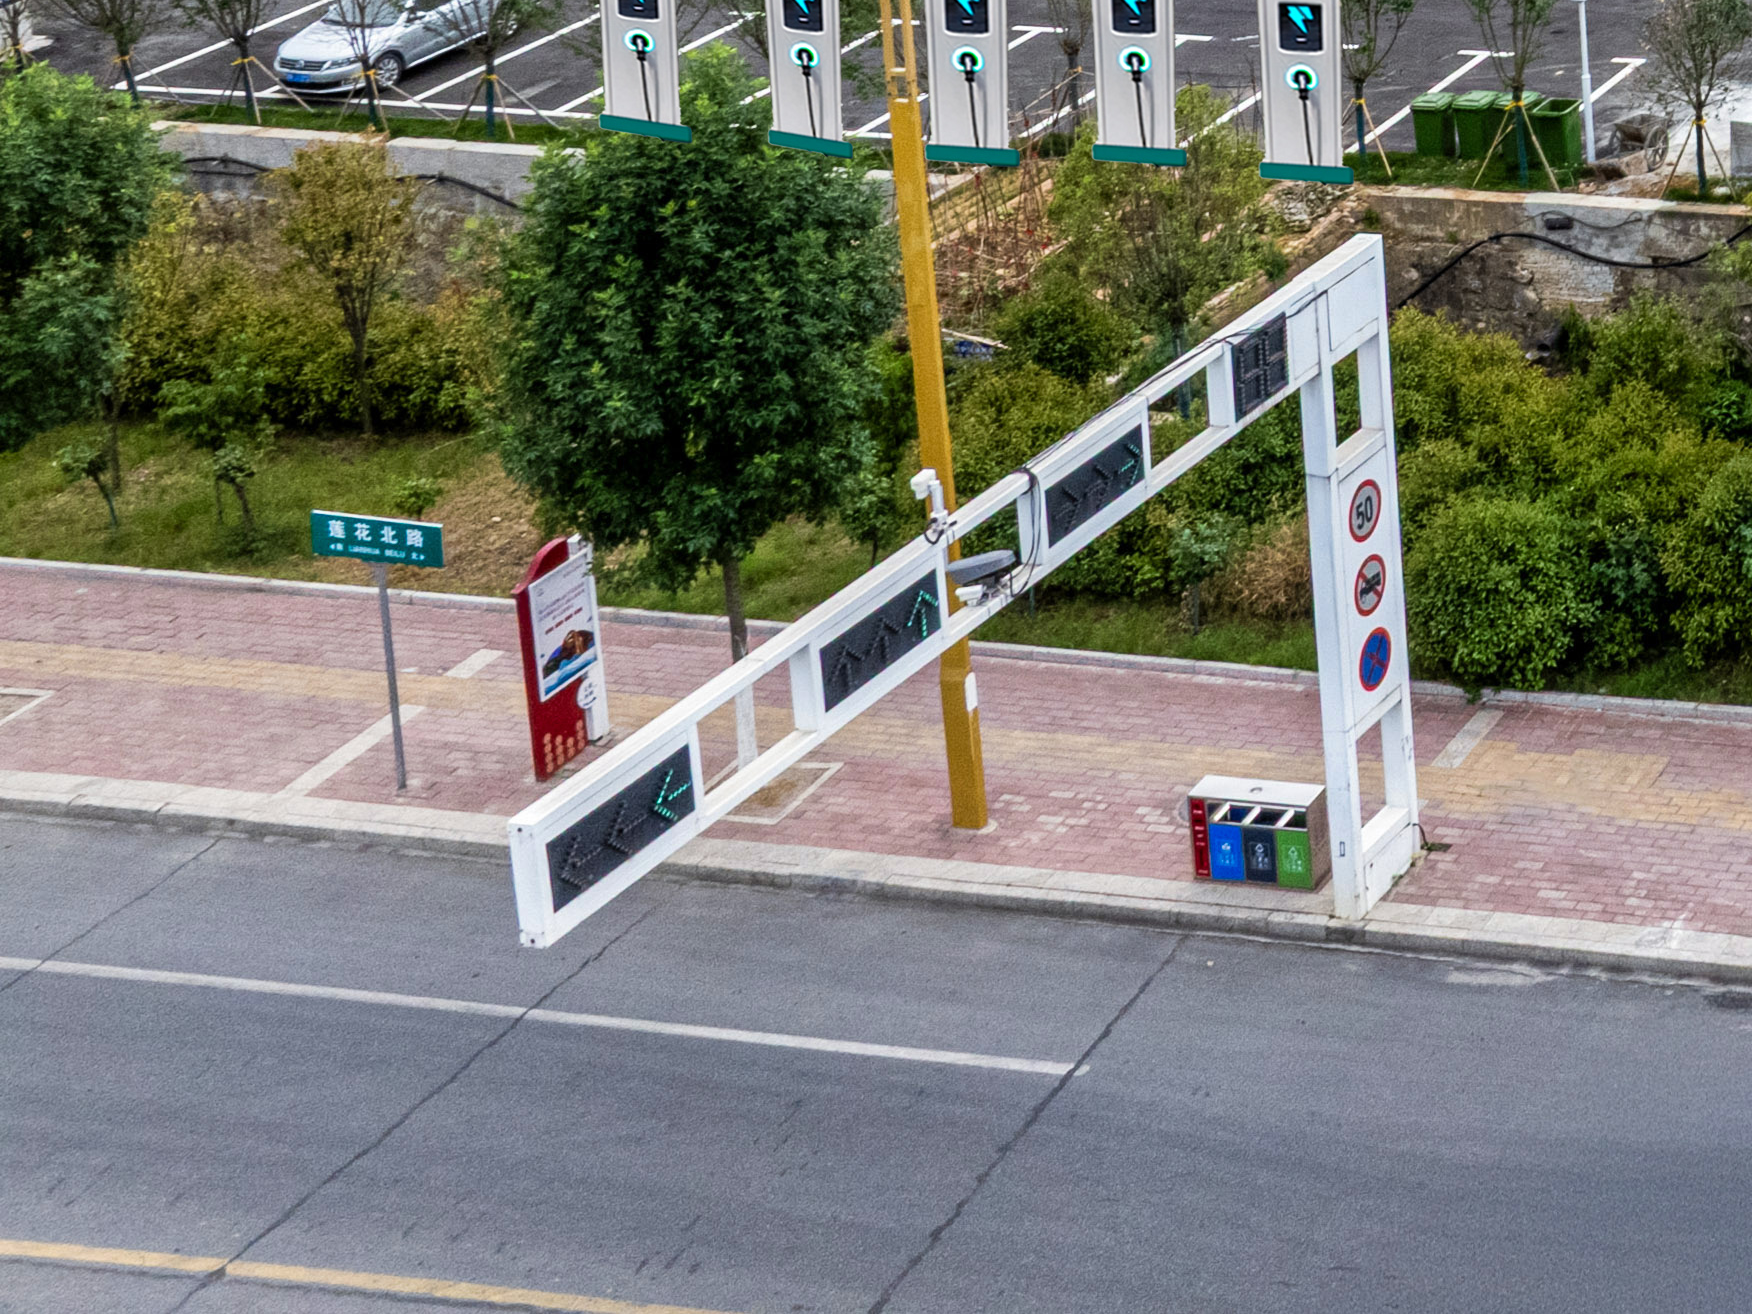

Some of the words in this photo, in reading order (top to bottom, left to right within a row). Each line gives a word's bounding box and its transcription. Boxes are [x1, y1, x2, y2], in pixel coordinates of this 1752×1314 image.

[1355, 495, 1374, 530] 50
[328, 519, 424, 548] 莲花北路
